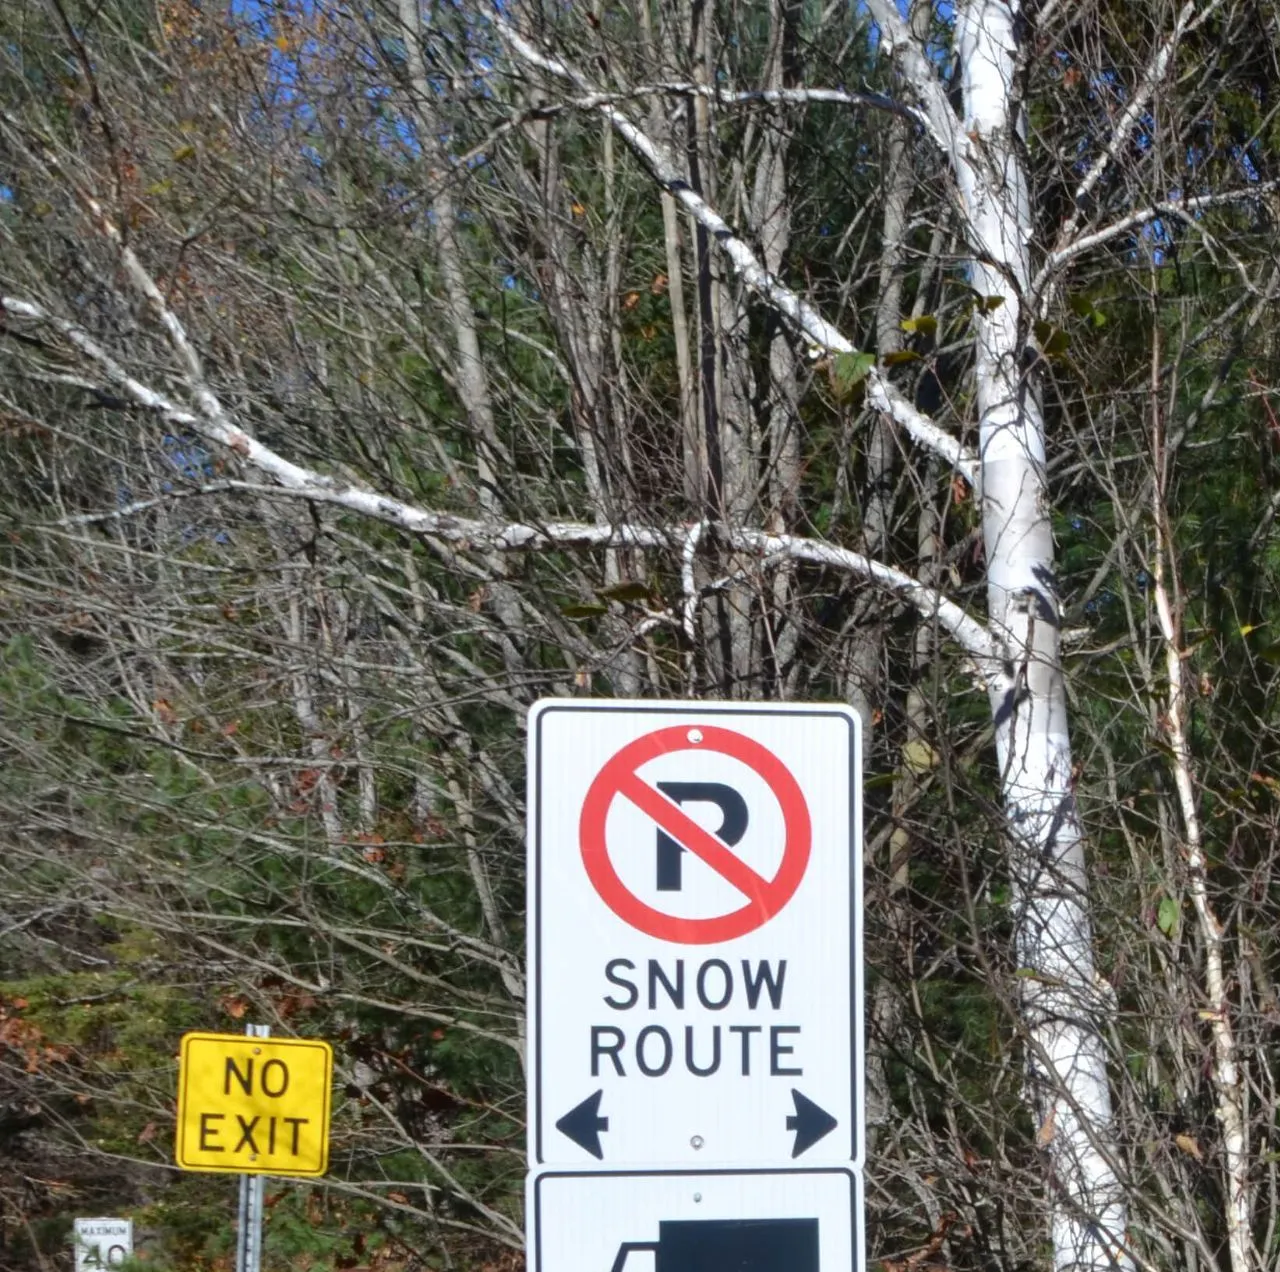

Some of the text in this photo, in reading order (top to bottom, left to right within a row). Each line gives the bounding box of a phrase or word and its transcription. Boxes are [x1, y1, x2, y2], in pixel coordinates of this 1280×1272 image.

[603, 958, 787, 1011] SNOW
[590, 1024, 804, 1077] ROUTE
[224, 1056, 290, 1098] NO
[199, 1112, 310, 1156] EXIT
[80, 1226, 127, 1235] MAXIMUM
[82, 1243, 128, 1270] 40
